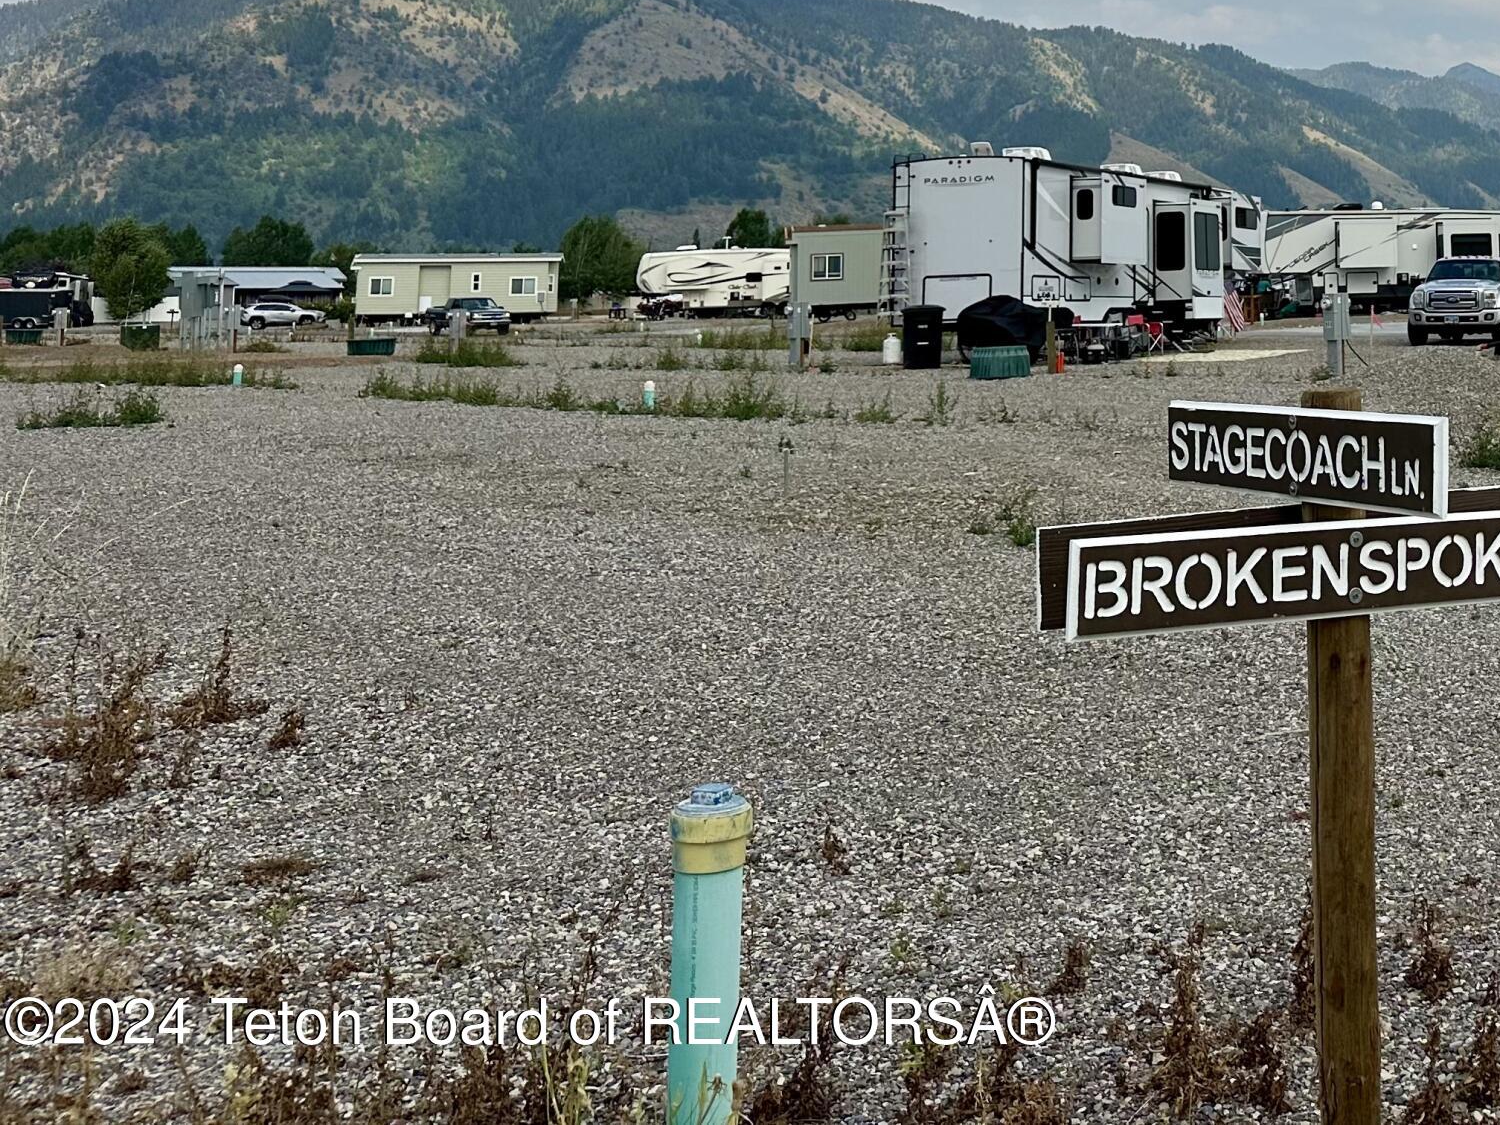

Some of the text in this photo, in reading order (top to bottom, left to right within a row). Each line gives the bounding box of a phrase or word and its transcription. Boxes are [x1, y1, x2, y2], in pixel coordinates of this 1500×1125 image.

[923, 175, 995, 184] PARADIGM
[1171, 421, 1425, 500] STAGECOACH LN.
[1084, 543, 1349, 620] BROKEN
